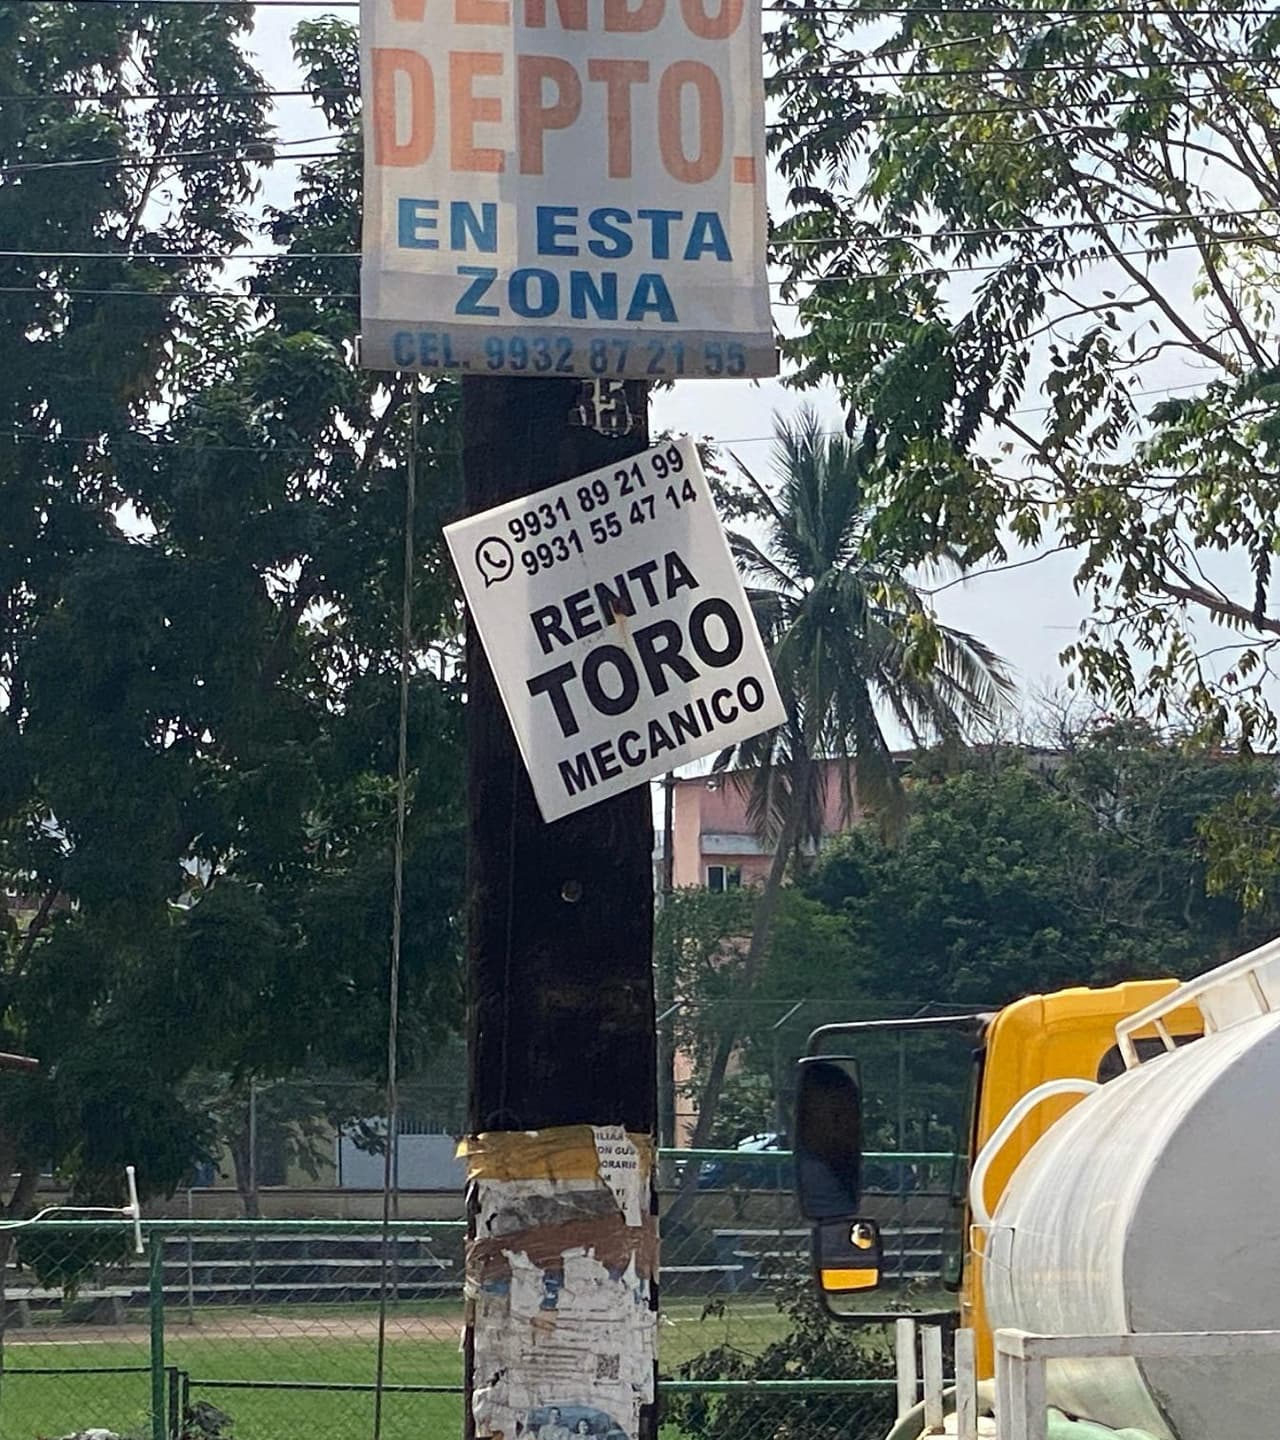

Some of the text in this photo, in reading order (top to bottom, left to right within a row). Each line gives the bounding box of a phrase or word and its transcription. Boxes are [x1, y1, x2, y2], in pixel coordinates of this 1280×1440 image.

[371, 47, 756, 184] DEPTO.
[397, 198, 733, 262] EN ESTA
[454, 266, 679, 323] ZONA
[392, 331, 747, 376] CEL. 9932 87 21 55
[507, 444, 685, 543] 9931 89 21 99
[520, 478, 698, 576] 9931 55 47 14
[529, 551, 700, 655] RENTA
[526, 597, 744, 739] TORO
[558, 676, 765, 797] MECANICO
